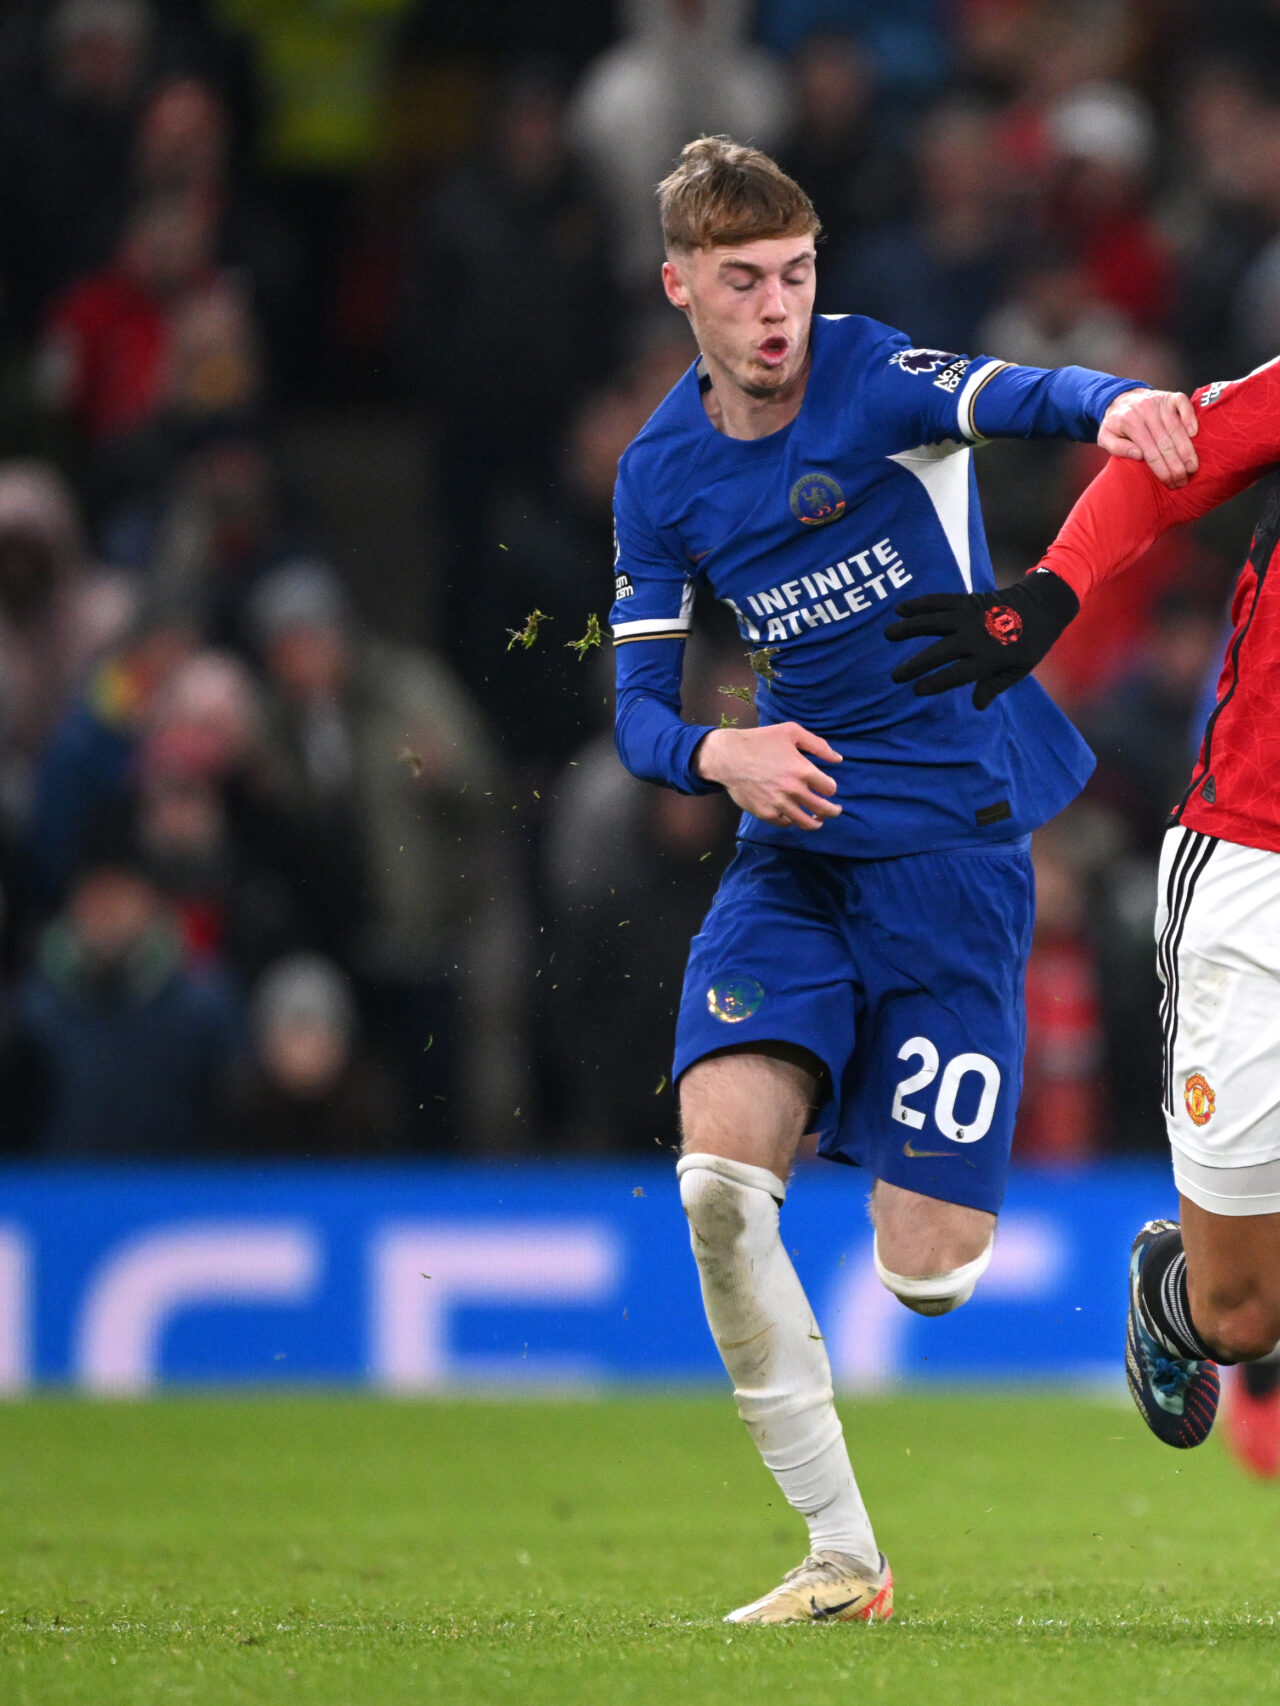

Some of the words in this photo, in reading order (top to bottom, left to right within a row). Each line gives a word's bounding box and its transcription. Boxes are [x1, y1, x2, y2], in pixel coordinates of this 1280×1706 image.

[747, 537, 899, 617] INFINITE
[767, 559, 913, 642] ATHLETE
[891, 1036, 1001, 1143] 20
